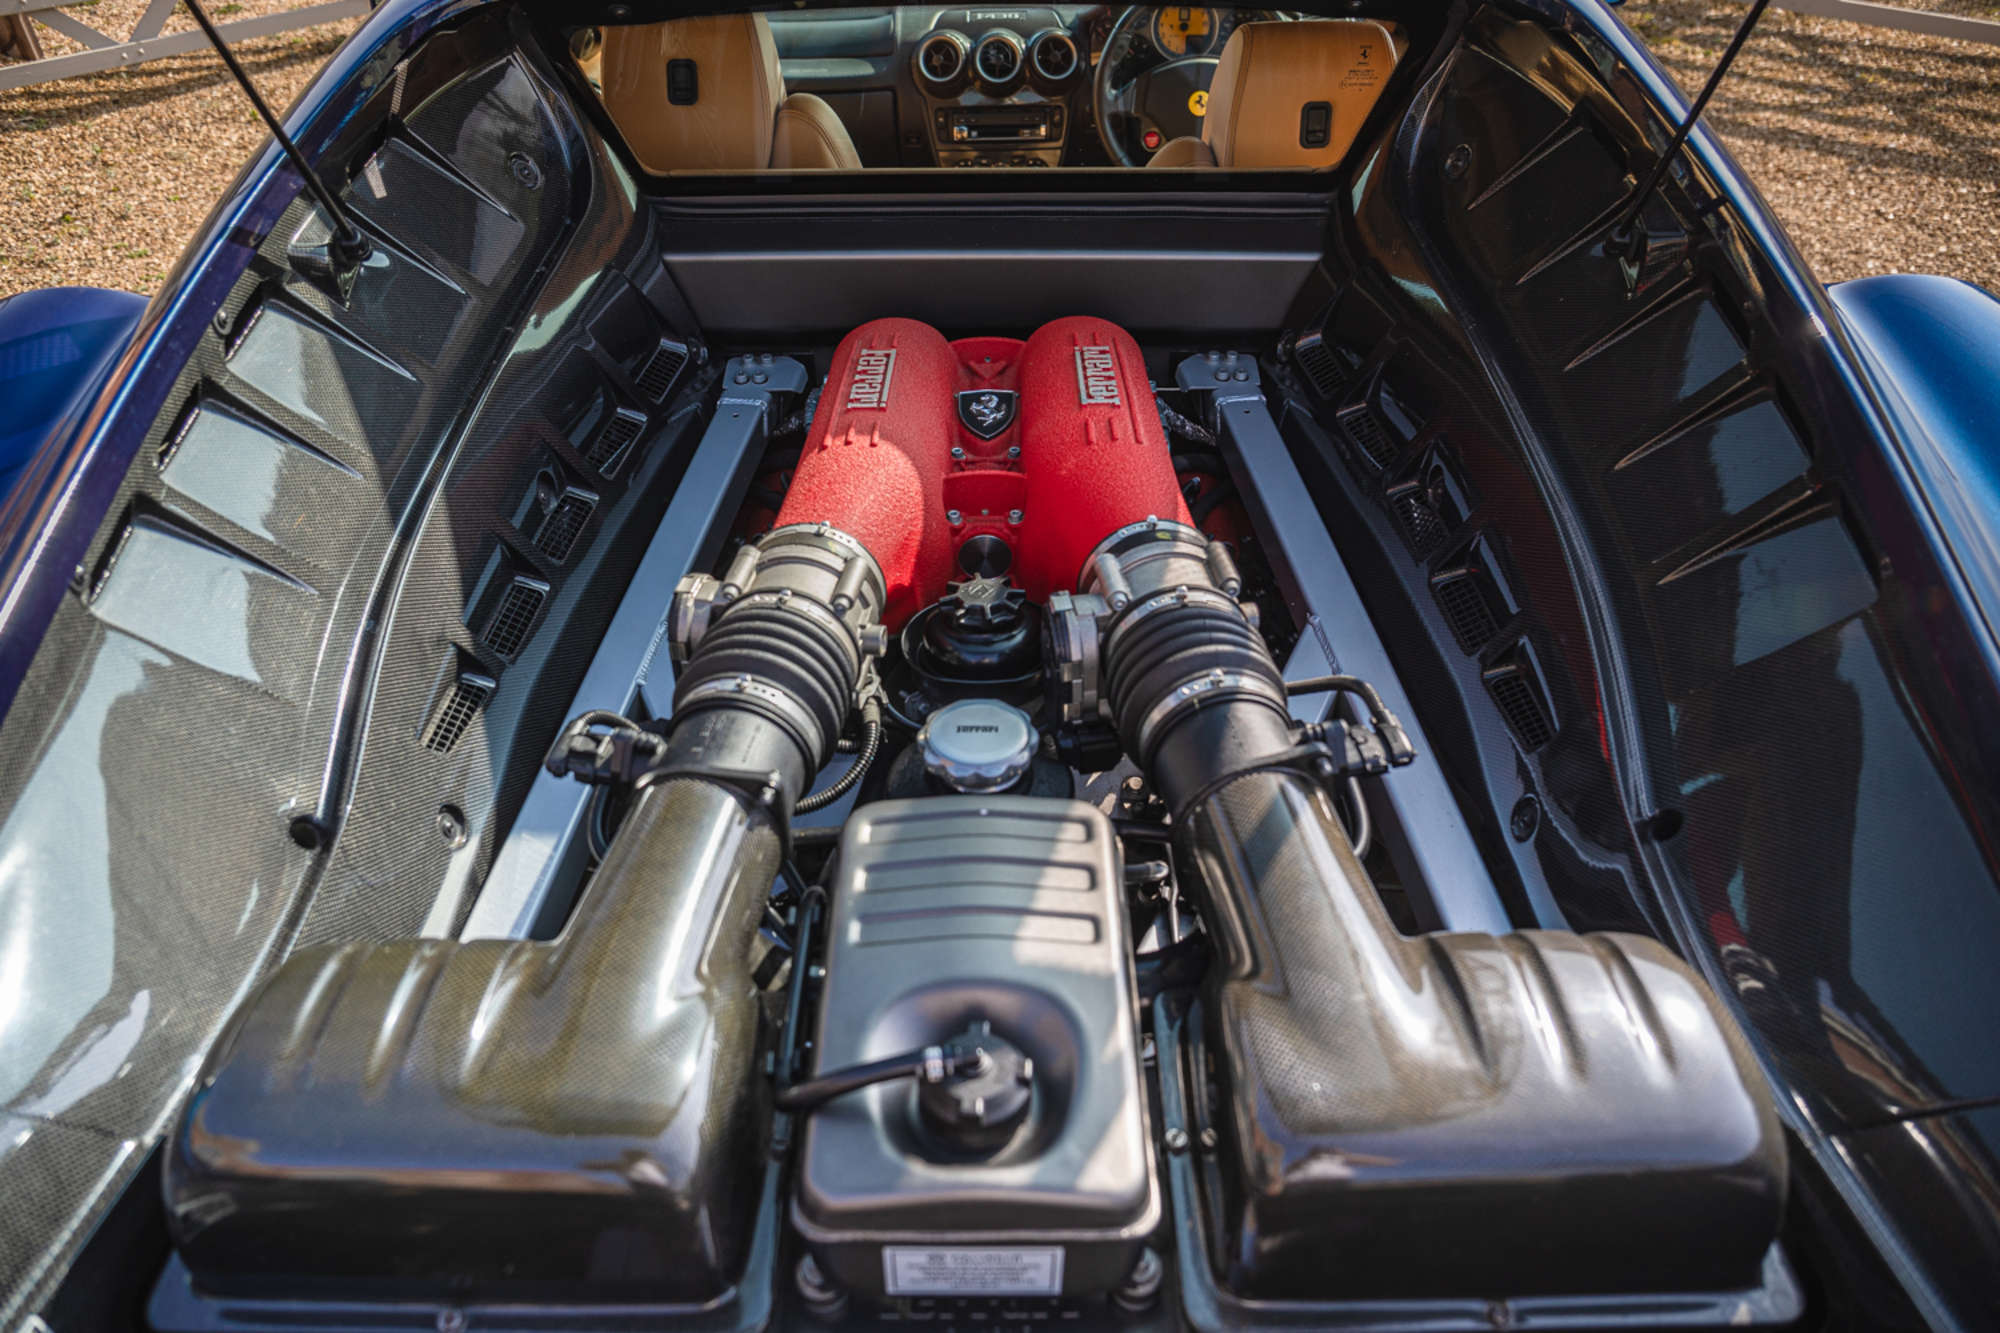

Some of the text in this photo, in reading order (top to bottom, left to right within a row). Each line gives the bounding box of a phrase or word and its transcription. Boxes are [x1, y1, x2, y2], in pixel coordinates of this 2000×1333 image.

[847, 349, 897, 408] Ferrari
[1074, 346, 1121, 405] Ferrari
[956, 725, 999, 733] Ferrari
